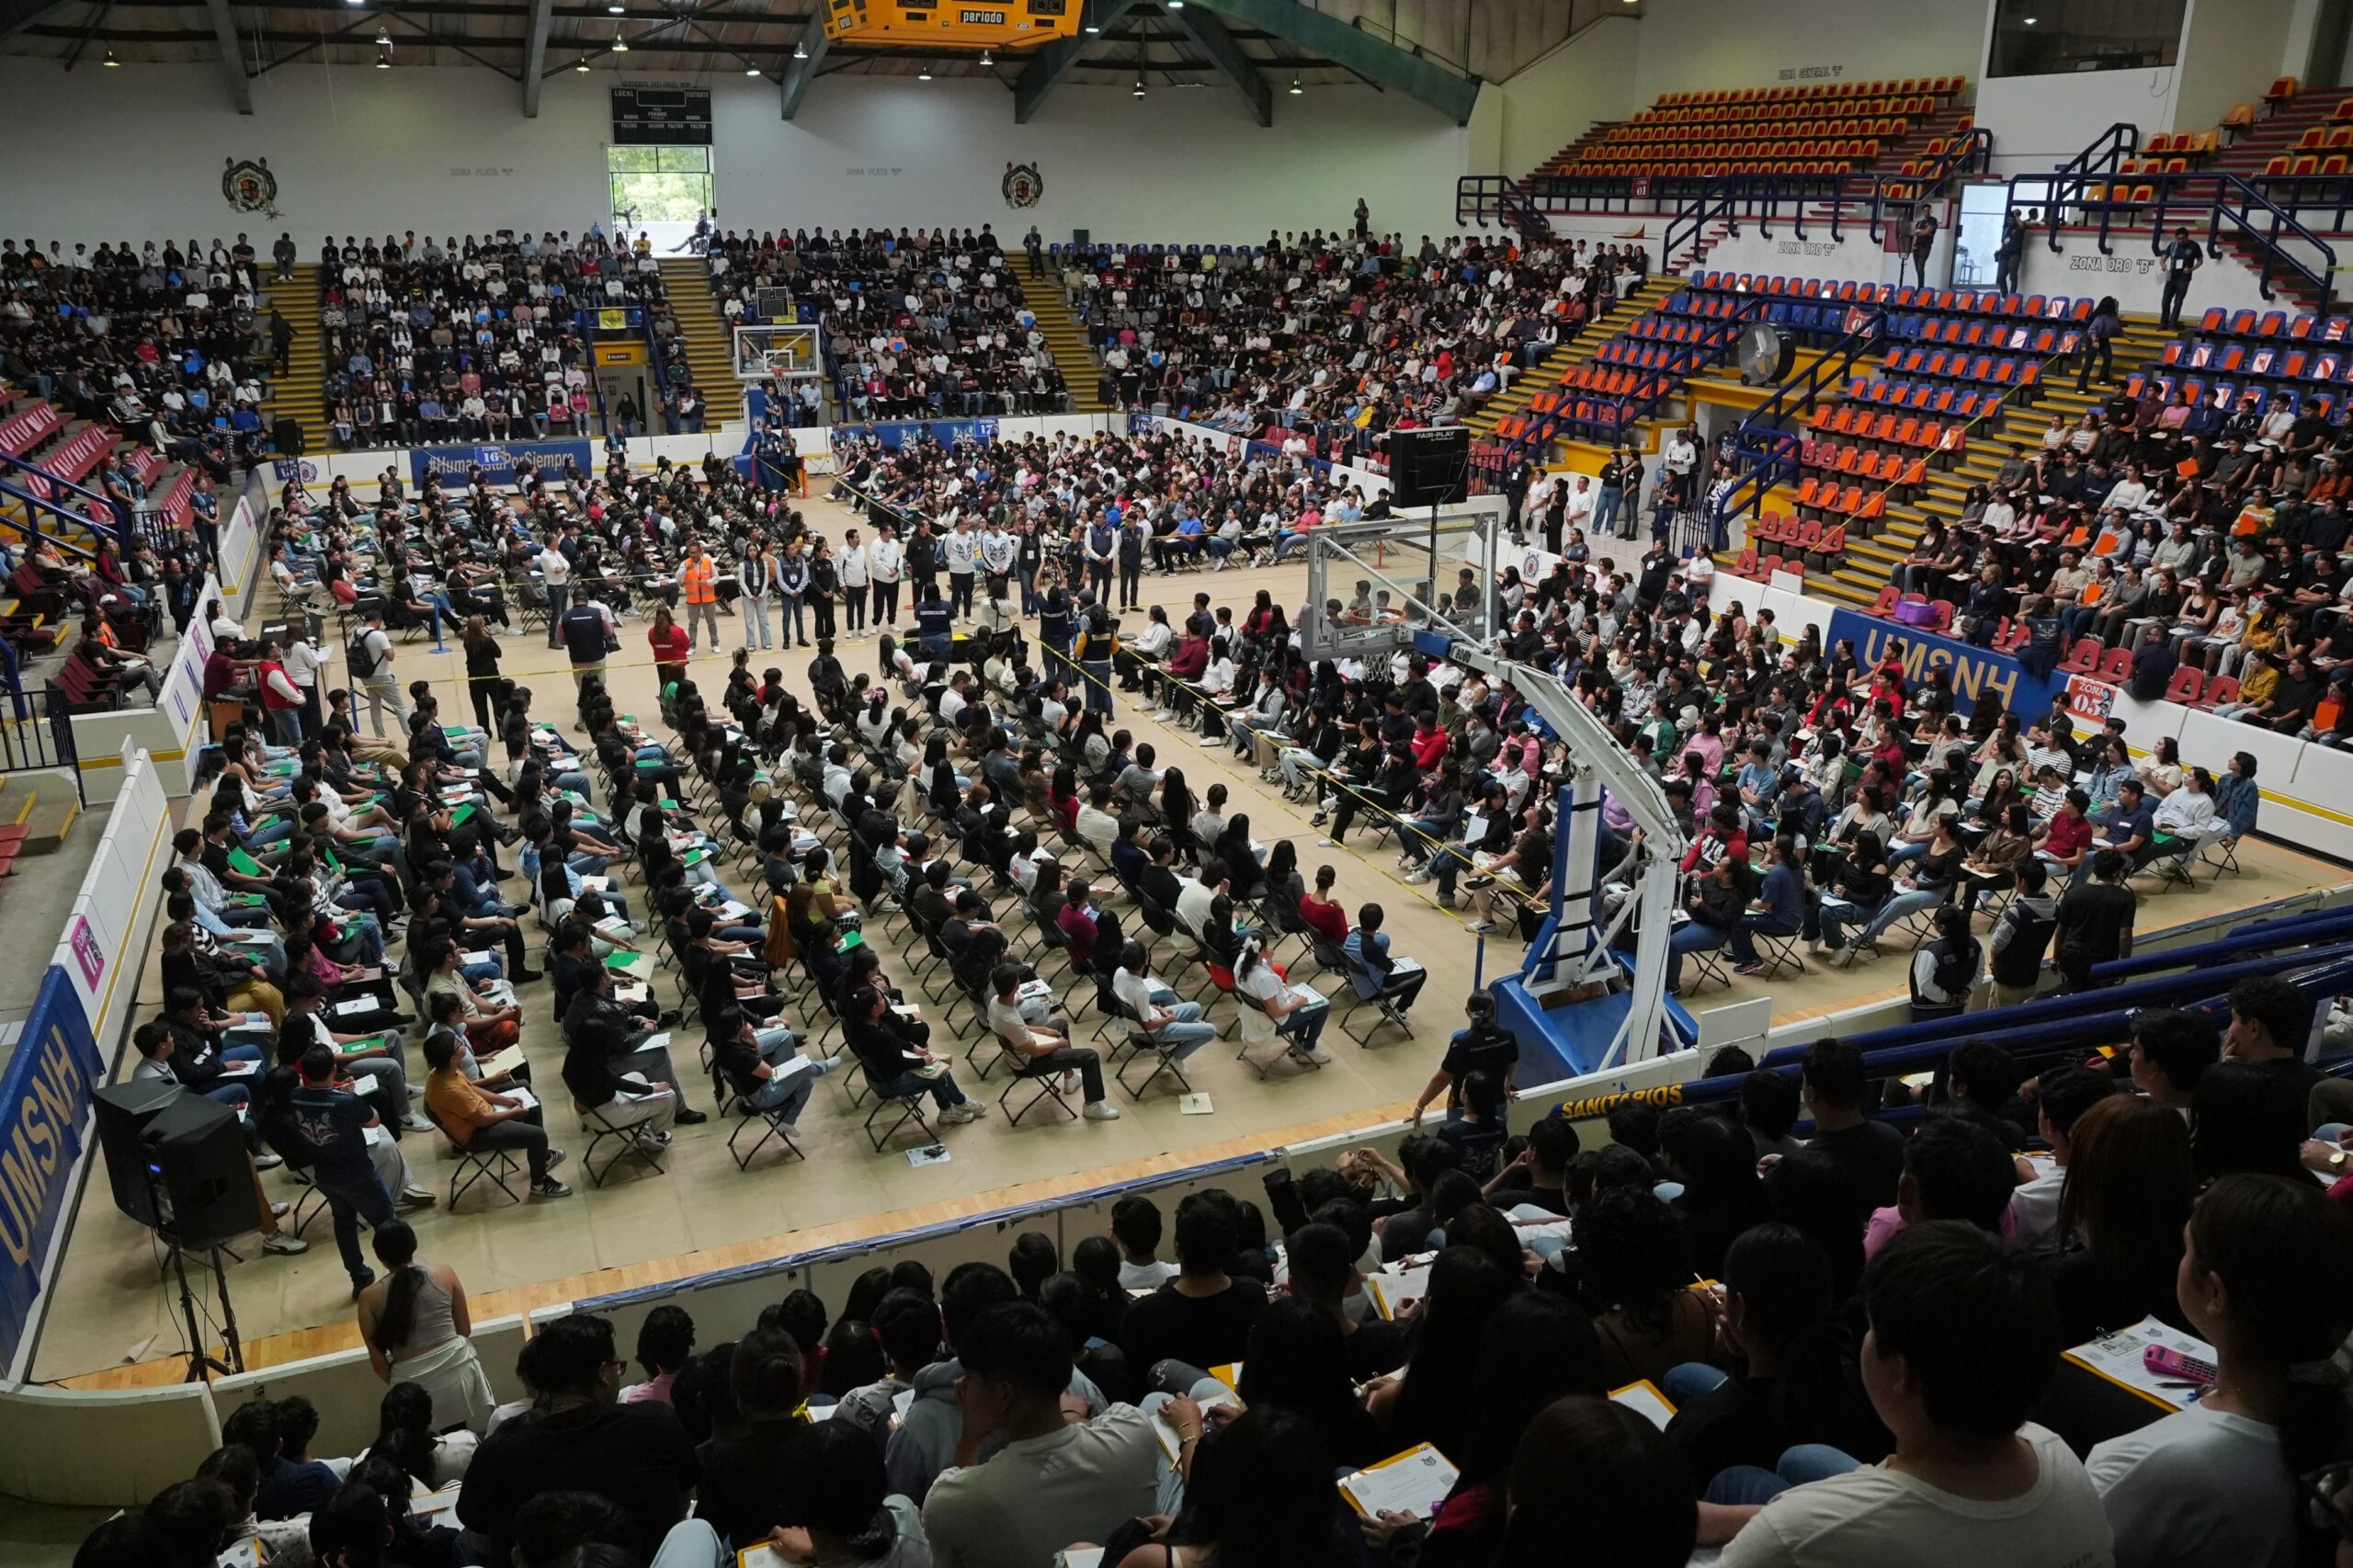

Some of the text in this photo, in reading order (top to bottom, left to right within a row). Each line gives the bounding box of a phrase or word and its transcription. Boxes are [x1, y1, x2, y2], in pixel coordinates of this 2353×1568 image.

[963, 12, 1002, 23] periodo
[1779, 242, 1801, 255] ZONA
[1804, 243, 1822, 256] ORO
[2070, 256, 2102, 271] ZONA
[2107, 258, 2131, 272] ORO
[1416, 431, 1455, 439] FAIR-PLAY
[483, 451, 499, 462] 16
[1864, 629, 2018, 711] UMSNH
[2078, 682, 2104, 697] ZONA
[2074, 694, 2102, 716] 05
